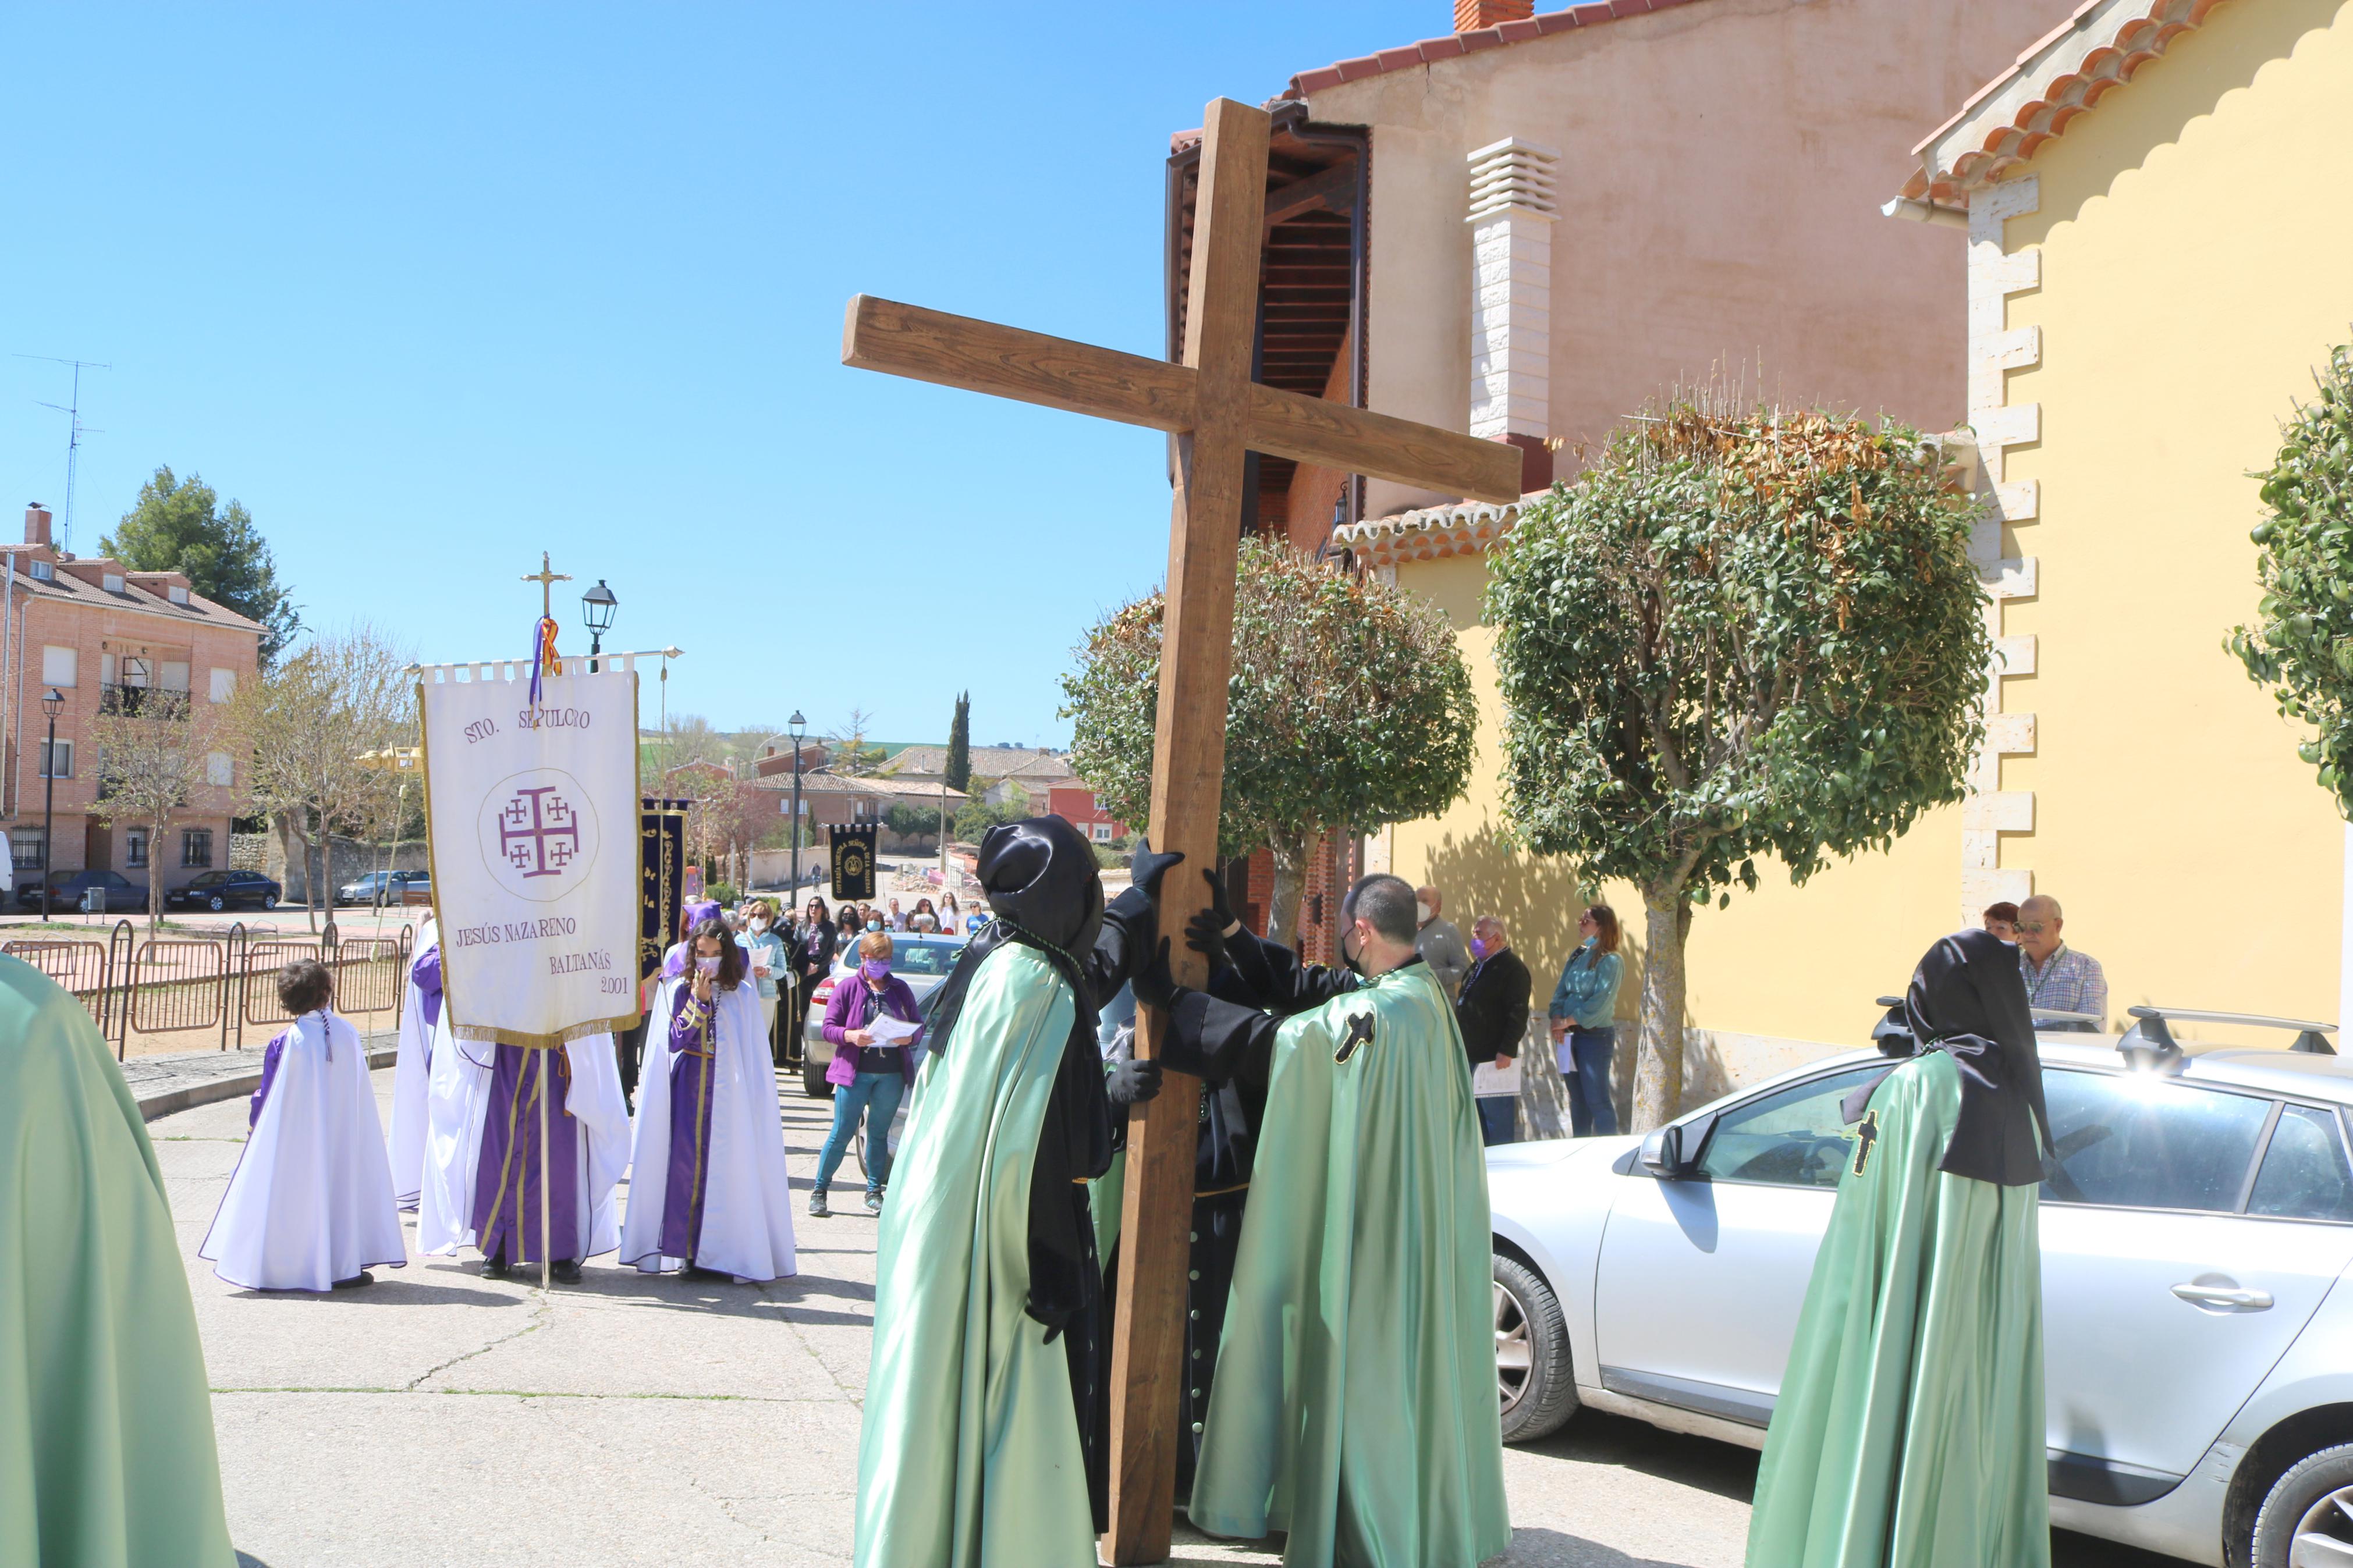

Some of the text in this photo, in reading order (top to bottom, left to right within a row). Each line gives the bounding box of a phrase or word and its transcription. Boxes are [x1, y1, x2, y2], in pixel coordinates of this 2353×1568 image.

[464, 718, 499, 744] STO.
[848, 839, 867, 851] SEÑORA
[644, 866, 656, 881] de
[644, 894, 655, 908] la
[456, 917, 576, 948] JESÚS NAZARENO
[549, 950, 611, 975] BALTANÁS
[601, 976, 629, 994] 2.001
